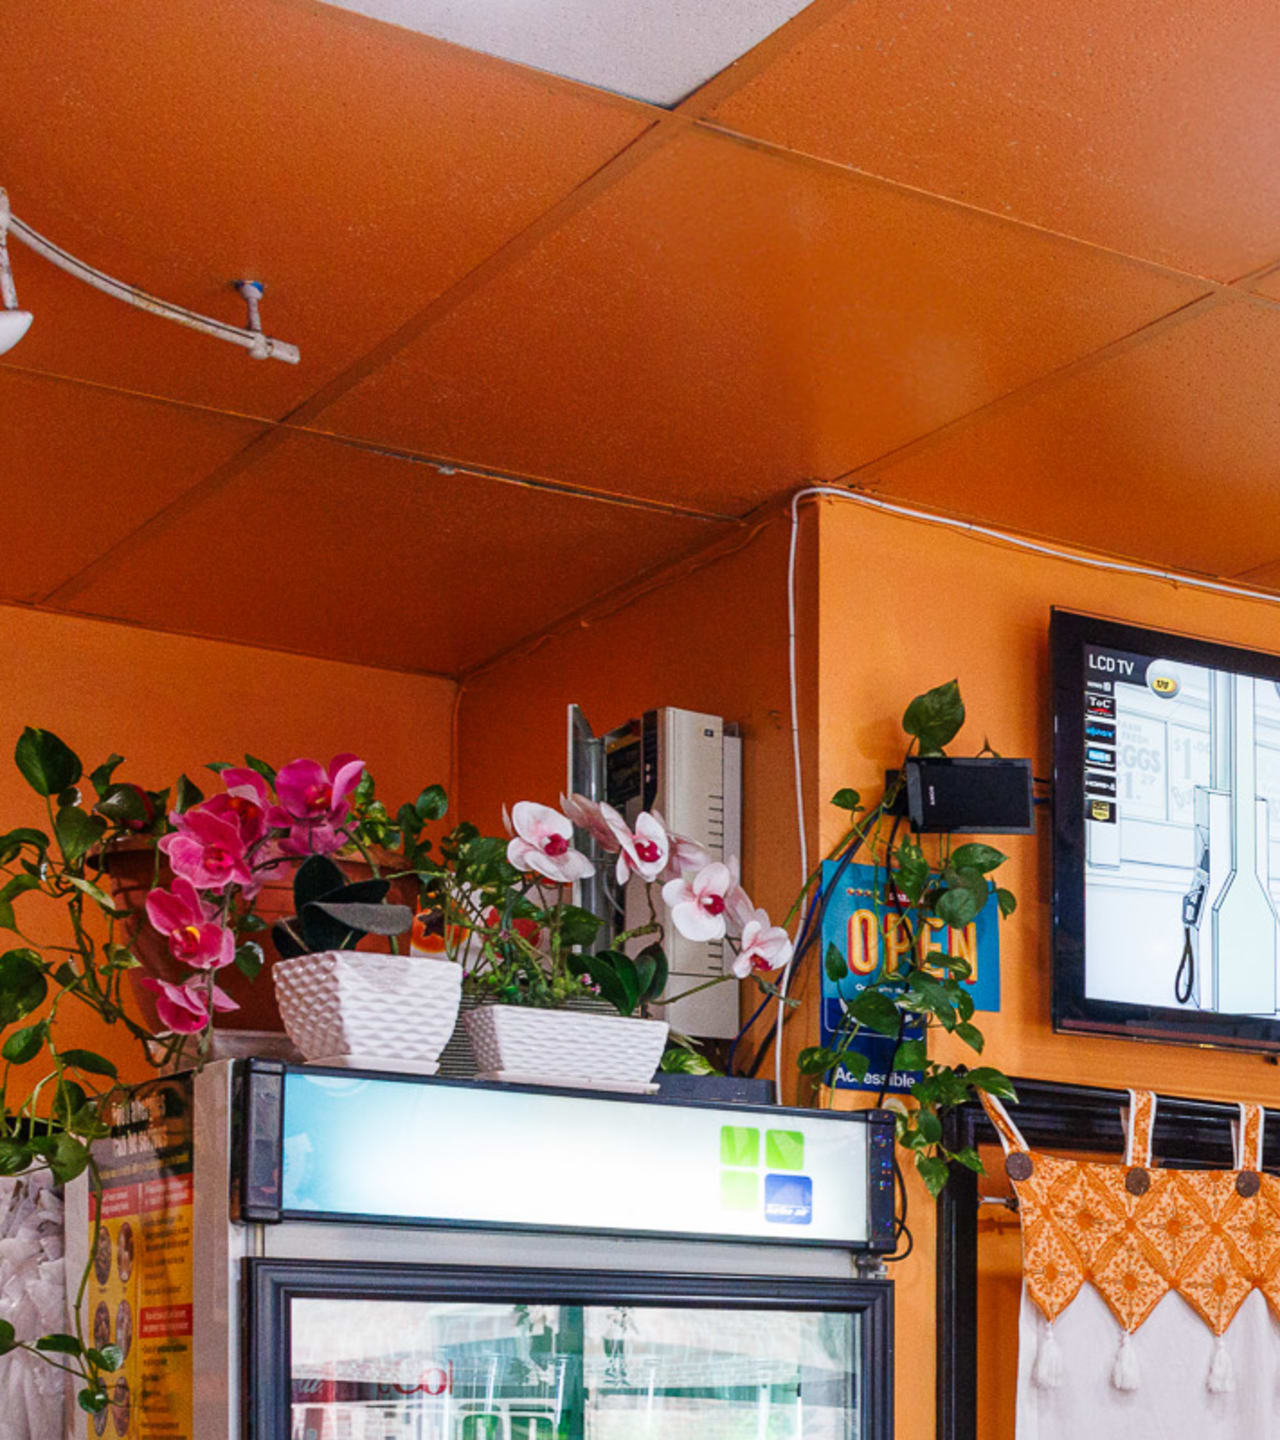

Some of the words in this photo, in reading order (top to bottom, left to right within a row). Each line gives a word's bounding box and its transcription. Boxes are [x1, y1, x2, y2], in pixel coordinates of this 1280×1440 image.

[1088, 654, 1115, 671] LCD
[1117, 660, 1135, 675] TV
[847, 908, 979, 985] OPEN
[834, 1065, 916, 1090] Acessible
